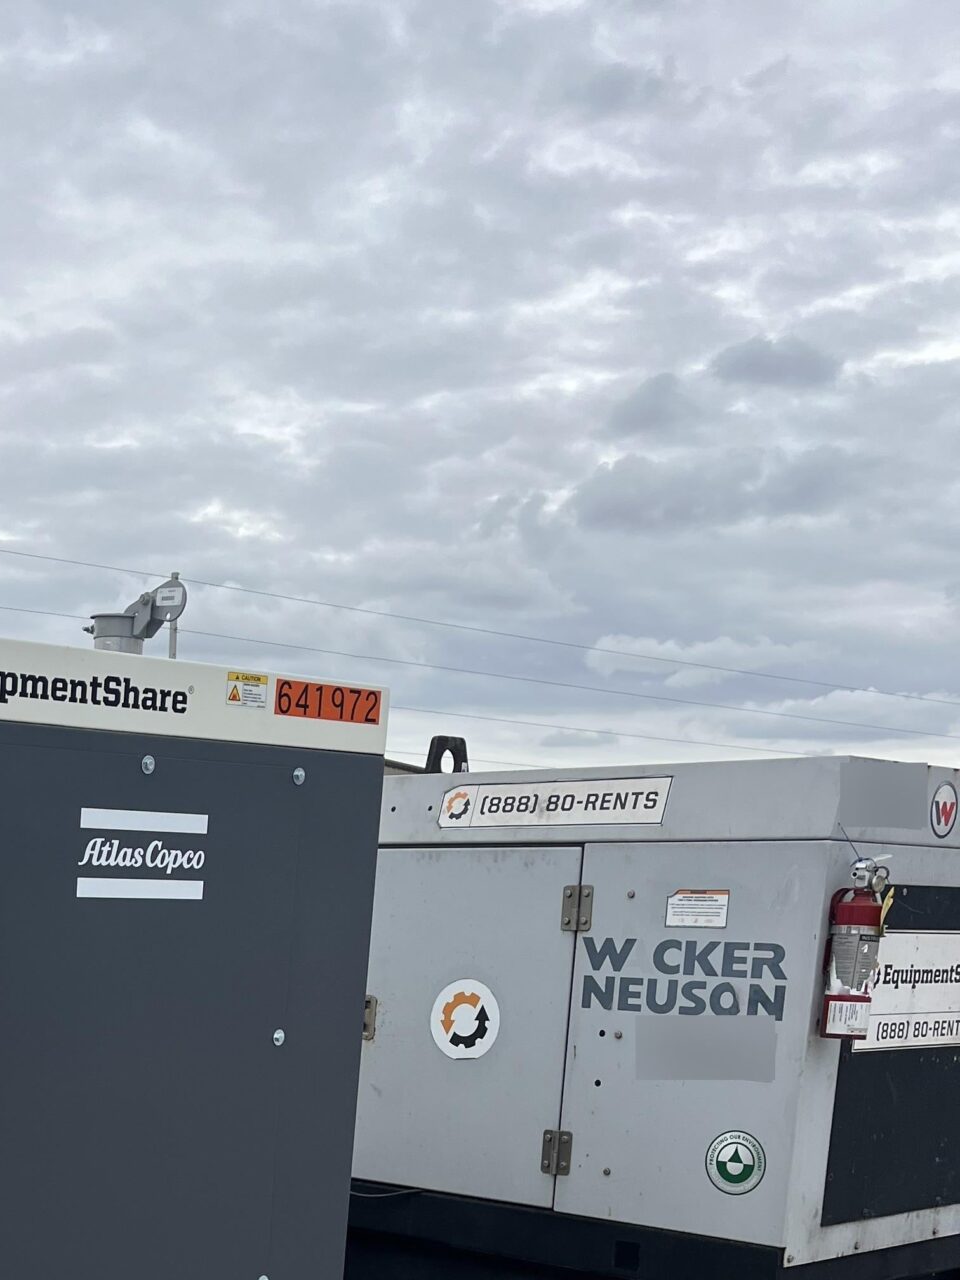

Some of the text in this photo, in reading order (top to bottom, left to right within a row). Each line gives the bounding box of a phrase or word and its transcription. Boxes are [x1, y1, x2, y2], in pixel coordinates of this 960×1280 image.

[241, 674, 261, 682] CAUTION
[278, 681, 378, 723] 641972
[480, 791, 659, 815] (888) 80-RENTS
[582, 936, 787, 980] WCKER
[581, 975, 786, 1021] NEUSON
[877, 1020, 910, 1041] (888)
